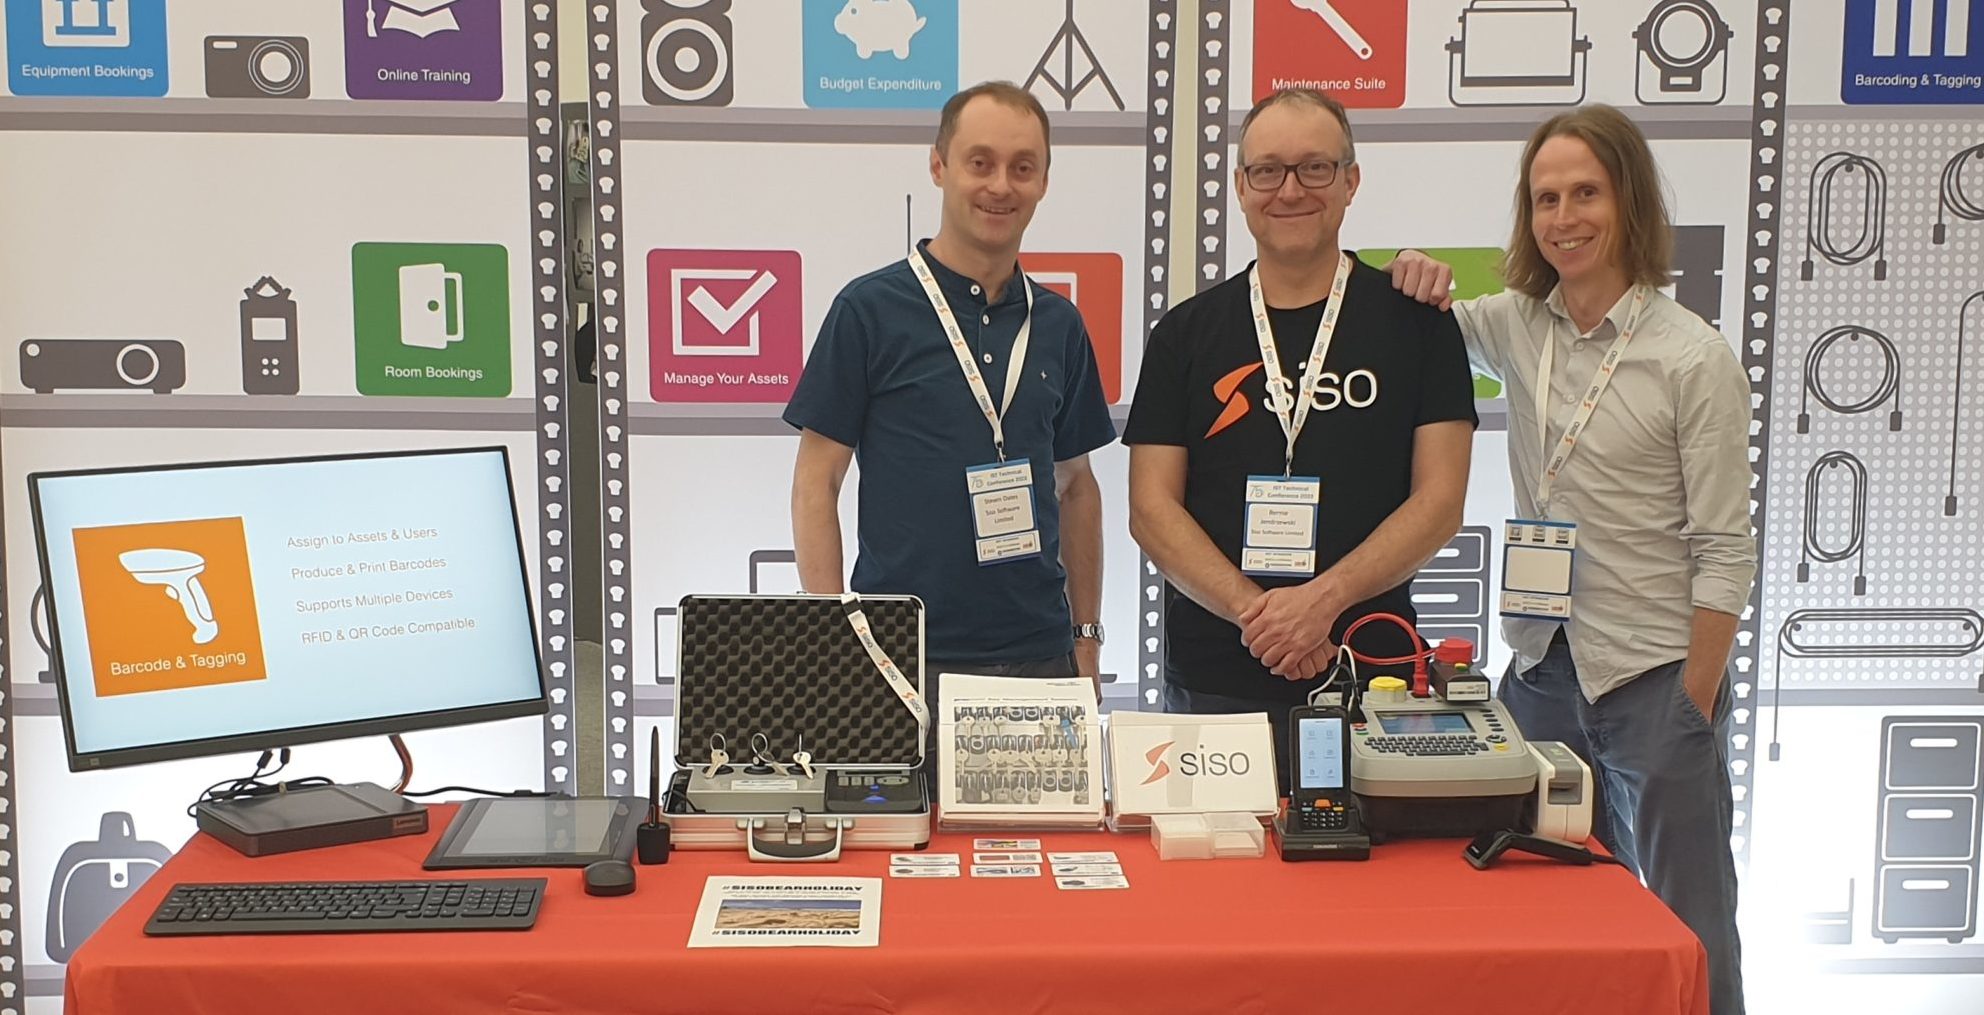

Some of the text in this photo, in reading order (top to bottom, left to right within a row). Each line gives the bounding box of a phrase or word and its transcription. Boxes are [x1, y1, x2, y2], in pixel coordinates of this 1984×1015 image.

[22, 64, 154, 80] Equipment Bookings
[377, 68, 471, 85] Online Training
[1855, 74, 1981, 88] Barcoding & Tagging
[820, 76, 942, 93] Budget Expenditure
[1272, 76, 1386, 90] Maintenance Suite
[385, 366, 483, 382] Room Bookings
[664, 372, 789, 387] Manage Your Assets
[1263, 361, 1378, 411] sso
[287, 527, 438, 549] Assign to Assets & Users
[291, 557, 447, 580] Produce & Print Barcodes
[296, 588, 454, 613] Supports Multiple Devices
[301, 617, 475, 645] RFID & QR Code Compatible
[110, 651, 247, 676] Barcode & Tagging
[1180, 744, 1250, 776] siso
